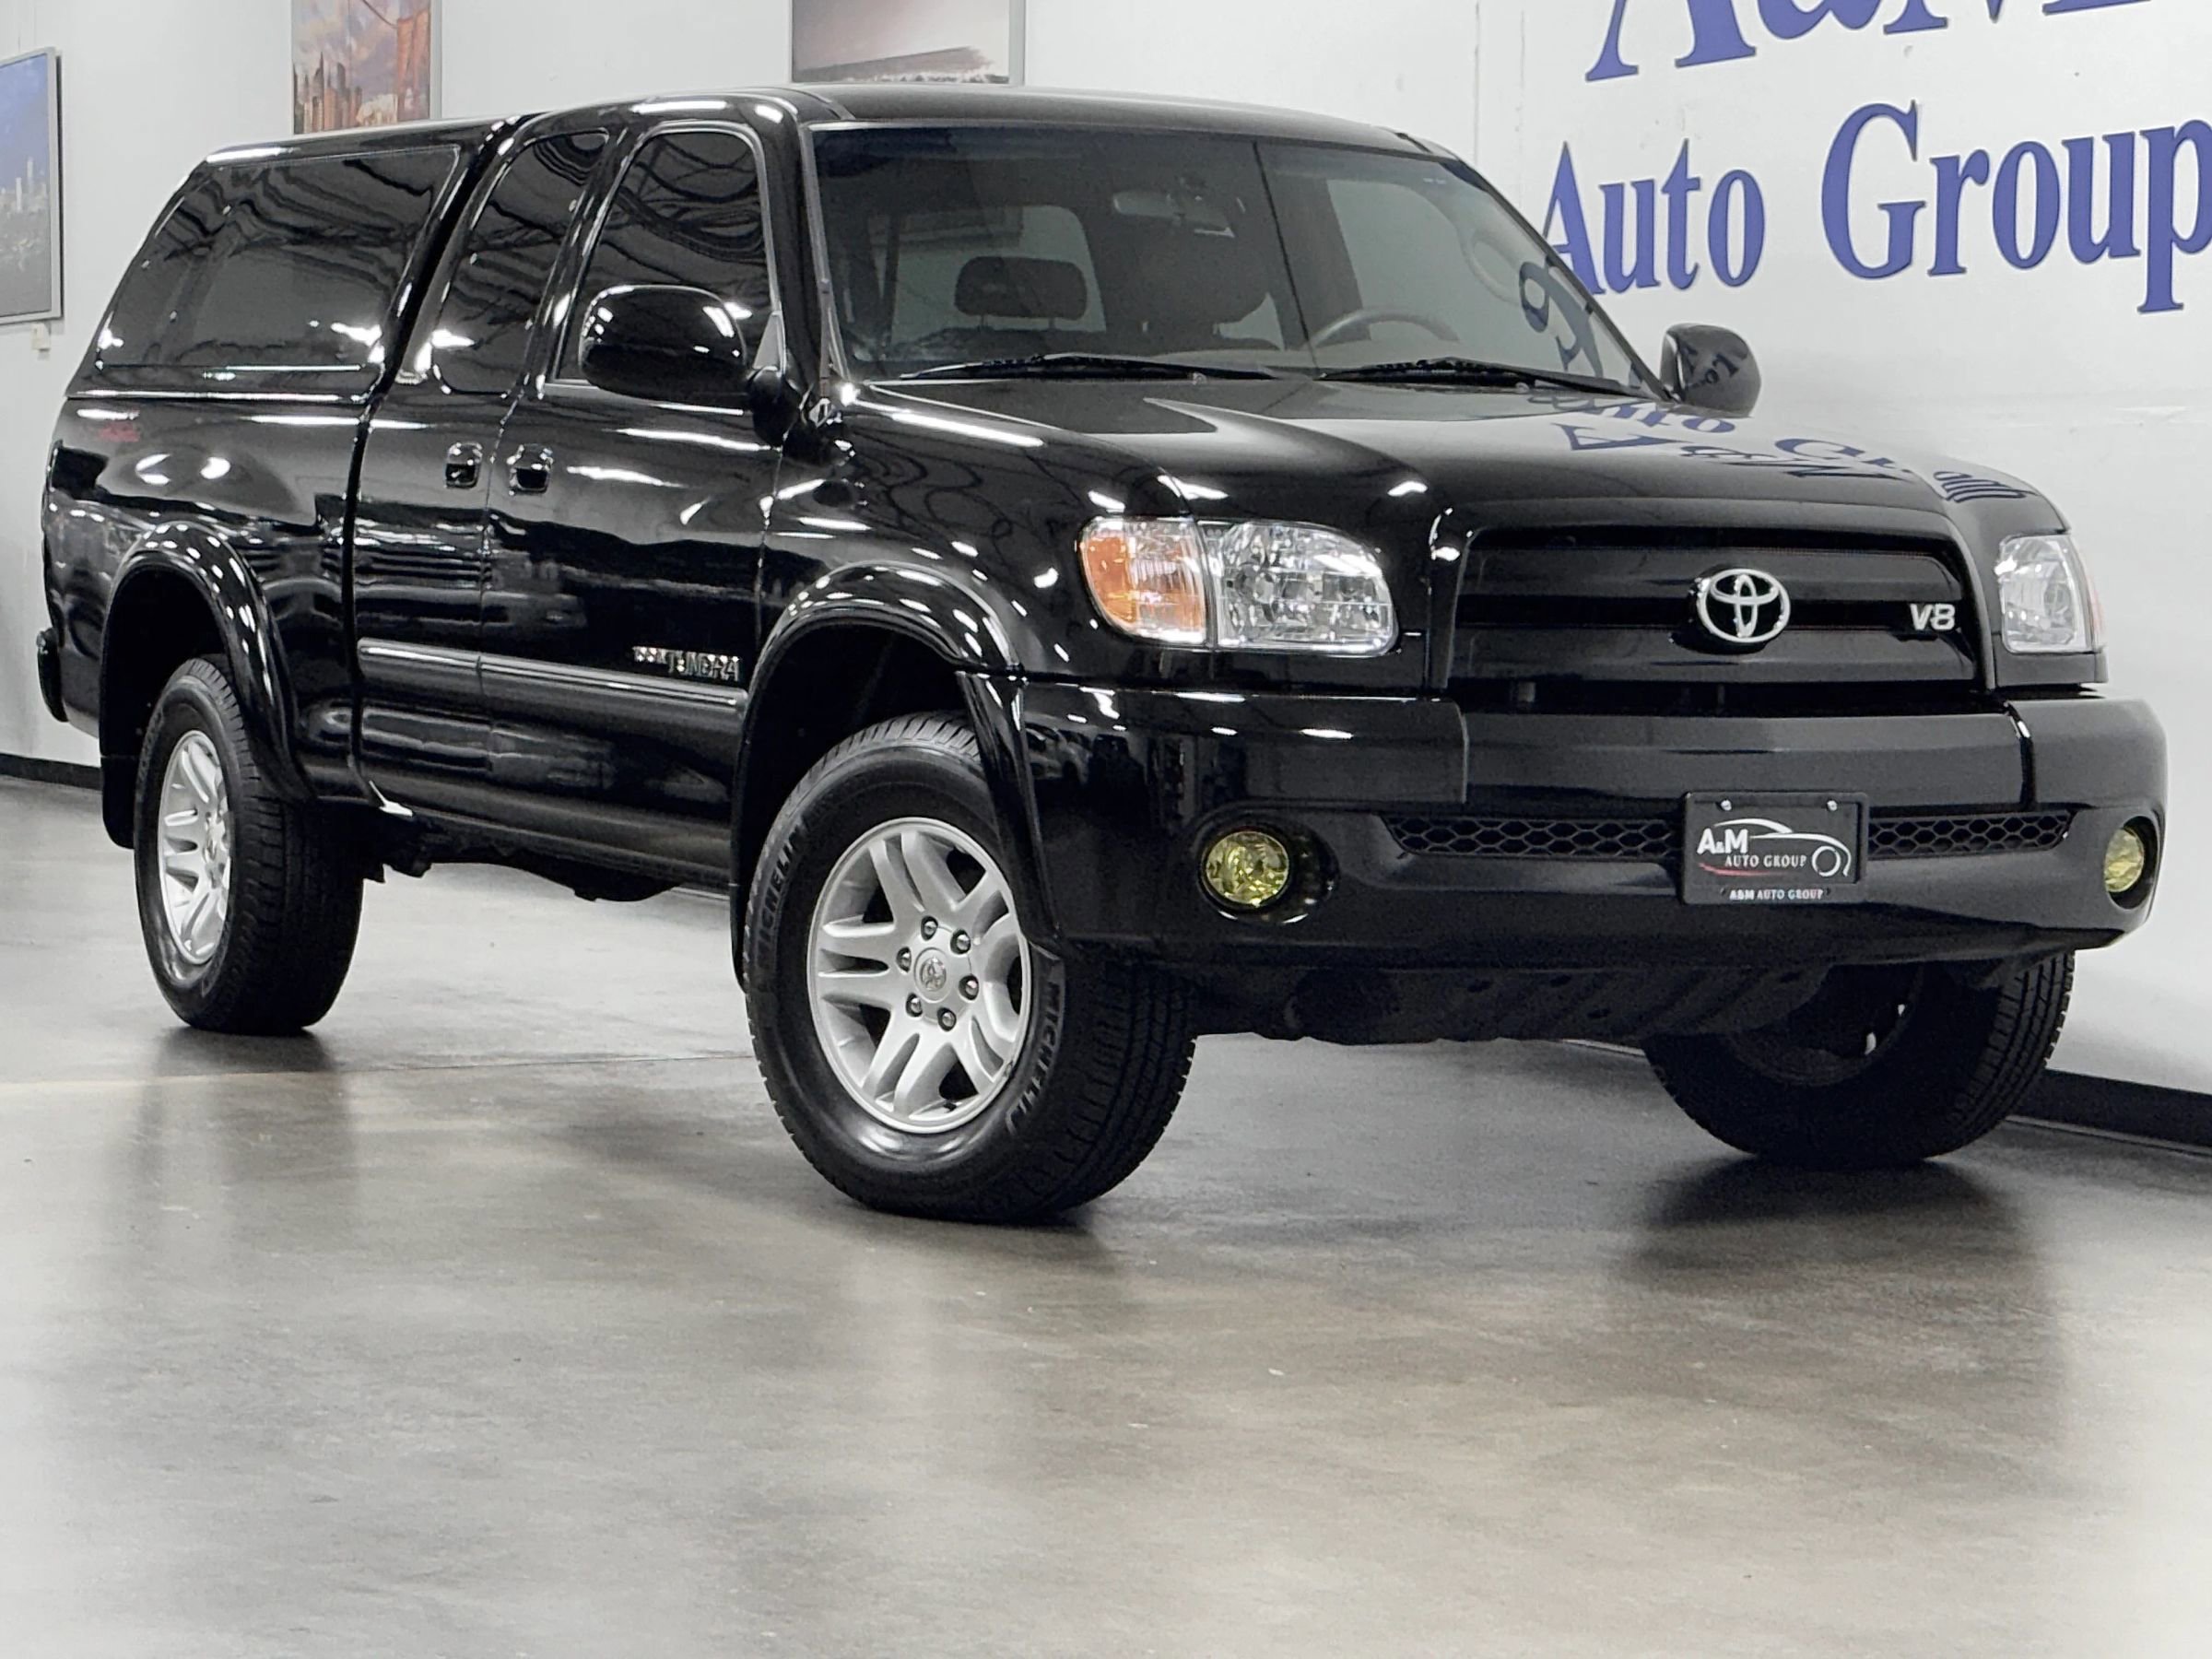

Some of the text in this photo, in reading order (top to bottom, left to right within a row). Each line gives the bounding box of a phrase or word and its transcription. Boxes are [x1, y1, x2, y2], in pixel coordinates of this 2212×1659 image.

[1542, 100, 2212, 315] Auto Group
[1910, 603, 1956, 631] V8
[1697, 828, 1748, 854] A&M
[1724, 854, 1807, 868] AUTO GROUP
[1757, 888, 1785, 900] AUTO
[1787, 888, 1824, 900] GROUP
